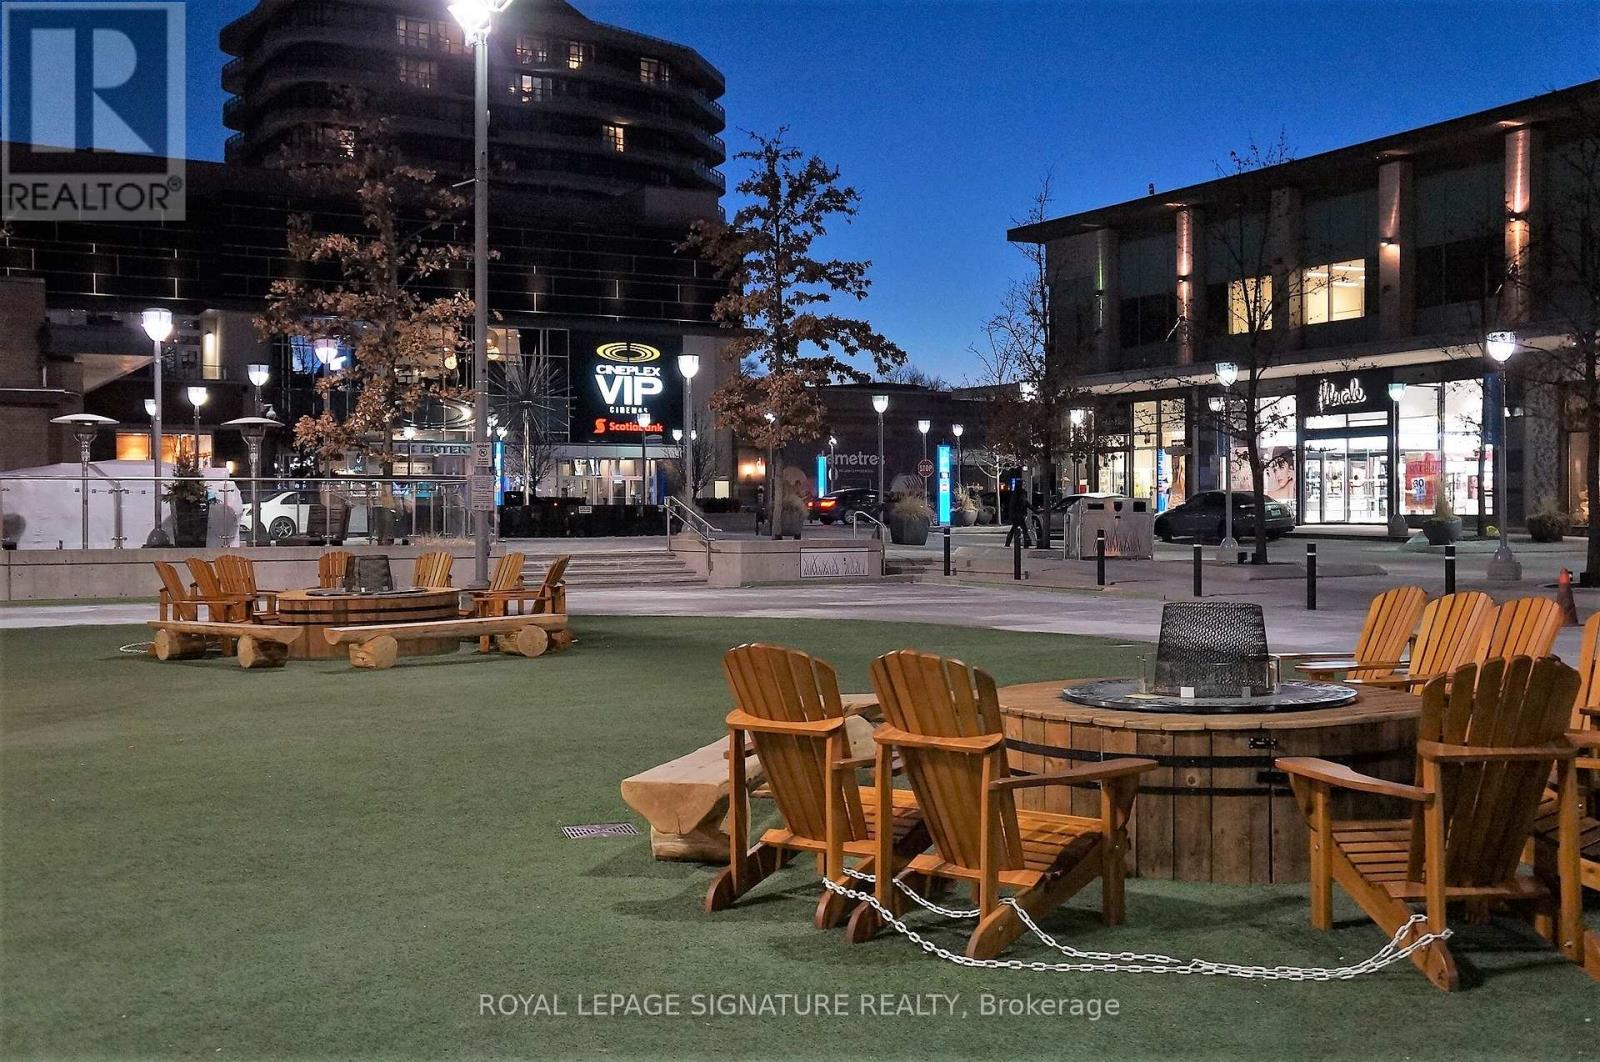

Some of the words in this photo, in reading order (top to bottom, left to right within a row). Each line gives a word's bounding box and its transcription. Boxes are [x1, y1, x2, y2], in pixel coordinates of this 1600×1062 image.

[595, 364, 661, 377] CINEPLEX
[594, 374, 664, 406] VIP
[609, 406, 648, 414] CINEMAS
